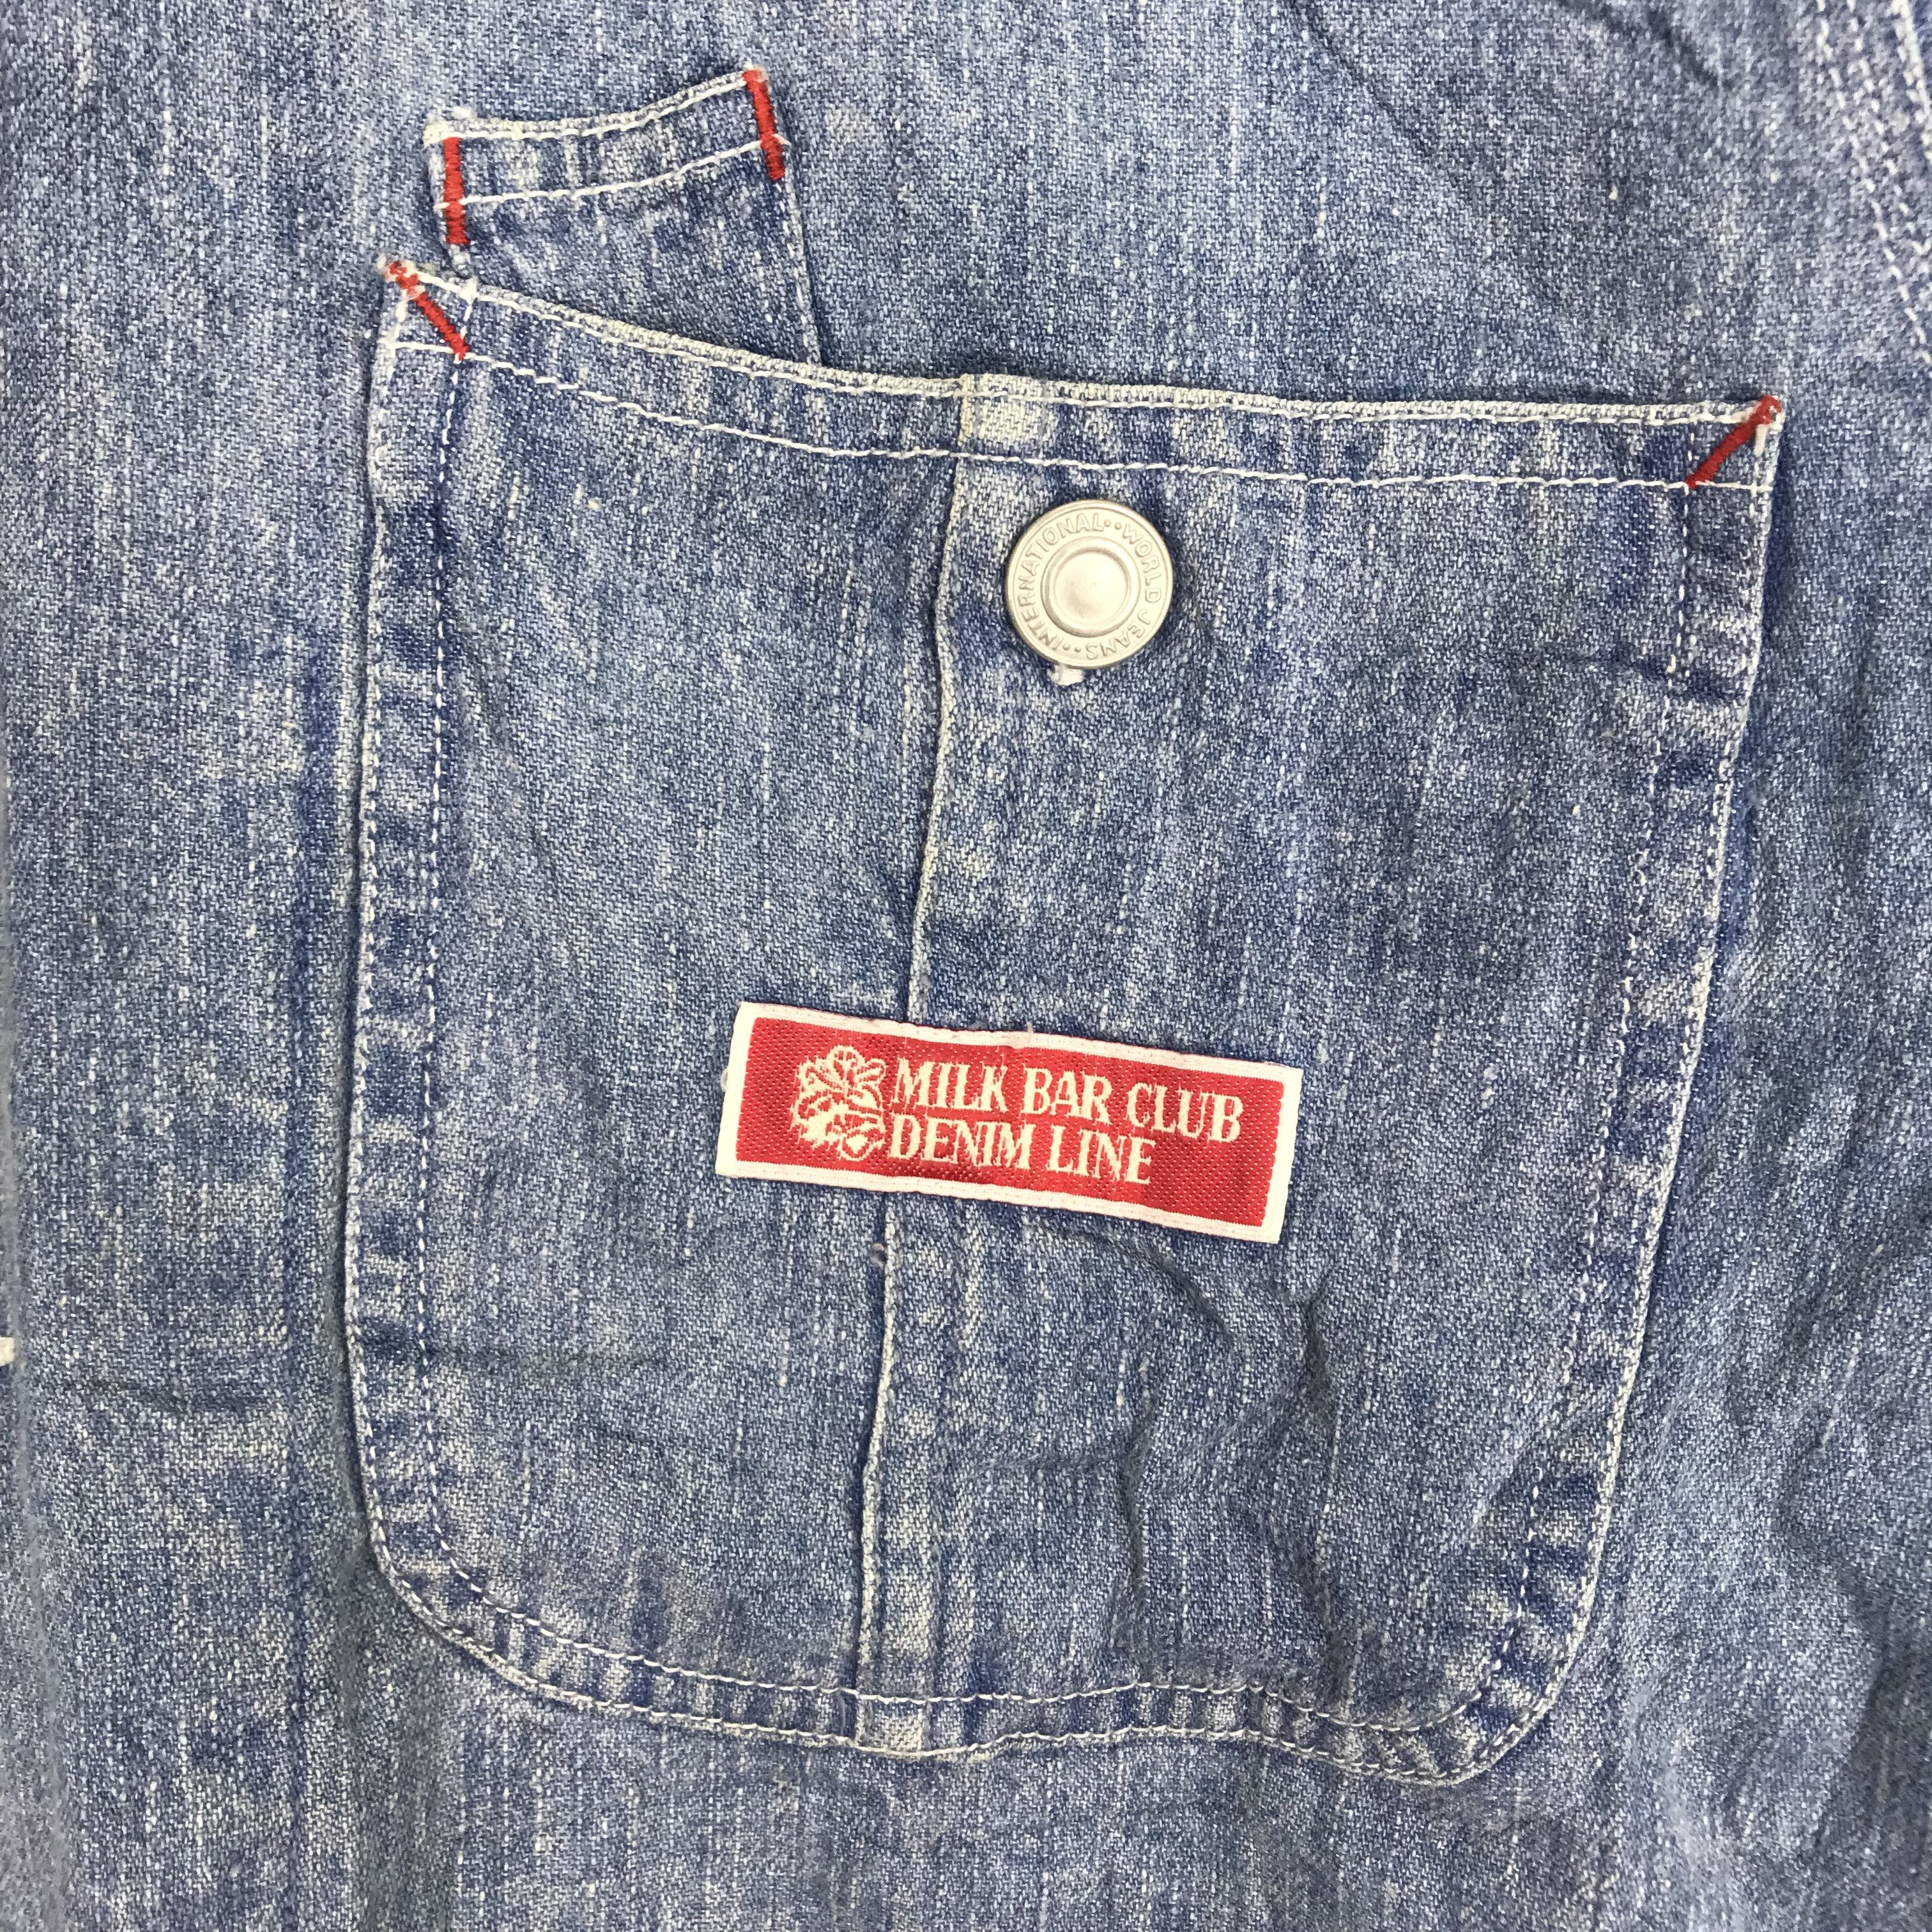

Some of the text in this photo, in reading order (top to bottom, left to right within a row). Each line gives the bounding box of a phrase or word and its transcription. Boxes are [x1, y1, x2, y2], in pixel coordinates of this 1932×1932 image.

[1017, 512, 1105, 651] INTERNATIONAL
[1085, 523, 1162, 660] WORLD JEANS
[887, 1112, 1154, 1185] DENIM LINE
[891, 1057, 1245, 1143] MILK BAR CLUB
